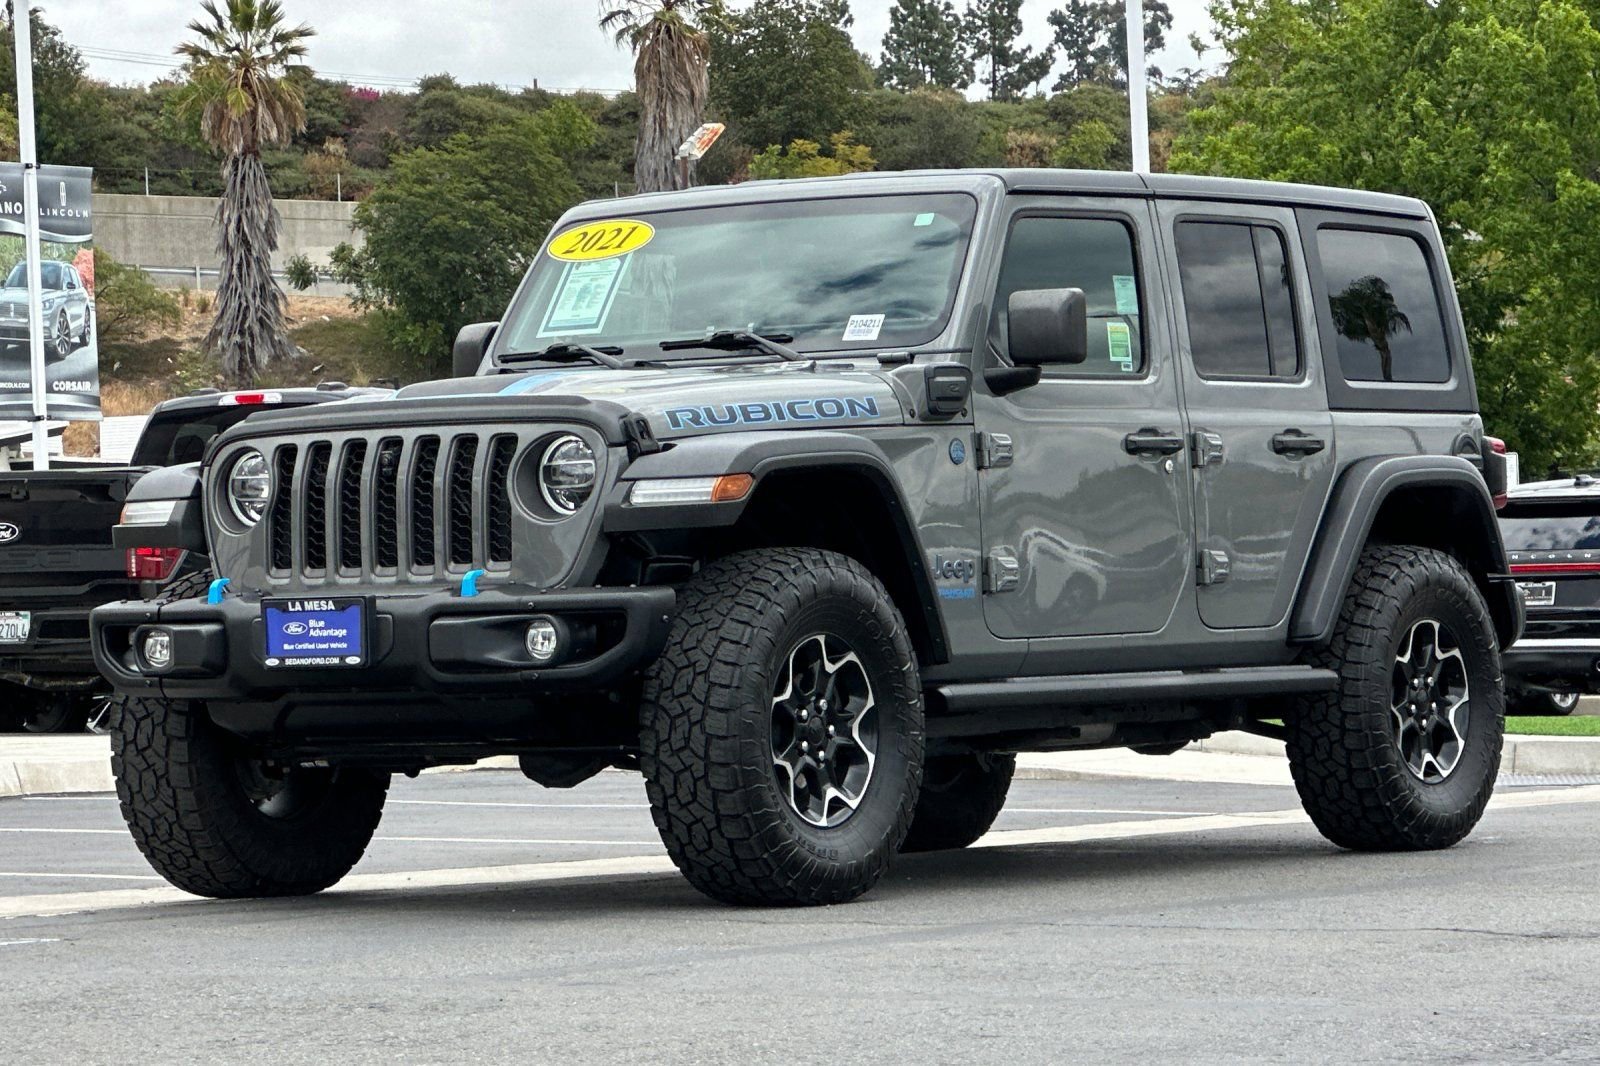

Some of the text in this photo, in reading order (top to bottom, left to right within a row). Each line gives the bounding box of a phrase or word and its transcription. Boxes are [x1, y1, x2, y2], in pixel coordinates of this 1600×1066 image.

[39, 207, 89, 218] LINCOLN
[561, 225, 640, 255] 2021
[52, 380, 92, 392] CORSAIR
[664, 396, 880, 430] RUBICON
[932, 554, 975, 584] Jeep
[288, 600, 335, 611] LA MESA
[308, 619, 325, 627] Blue
[308, 628, 347, 637] Advantage
[284, 657, 340, 666] SEDANOFORD.COM
